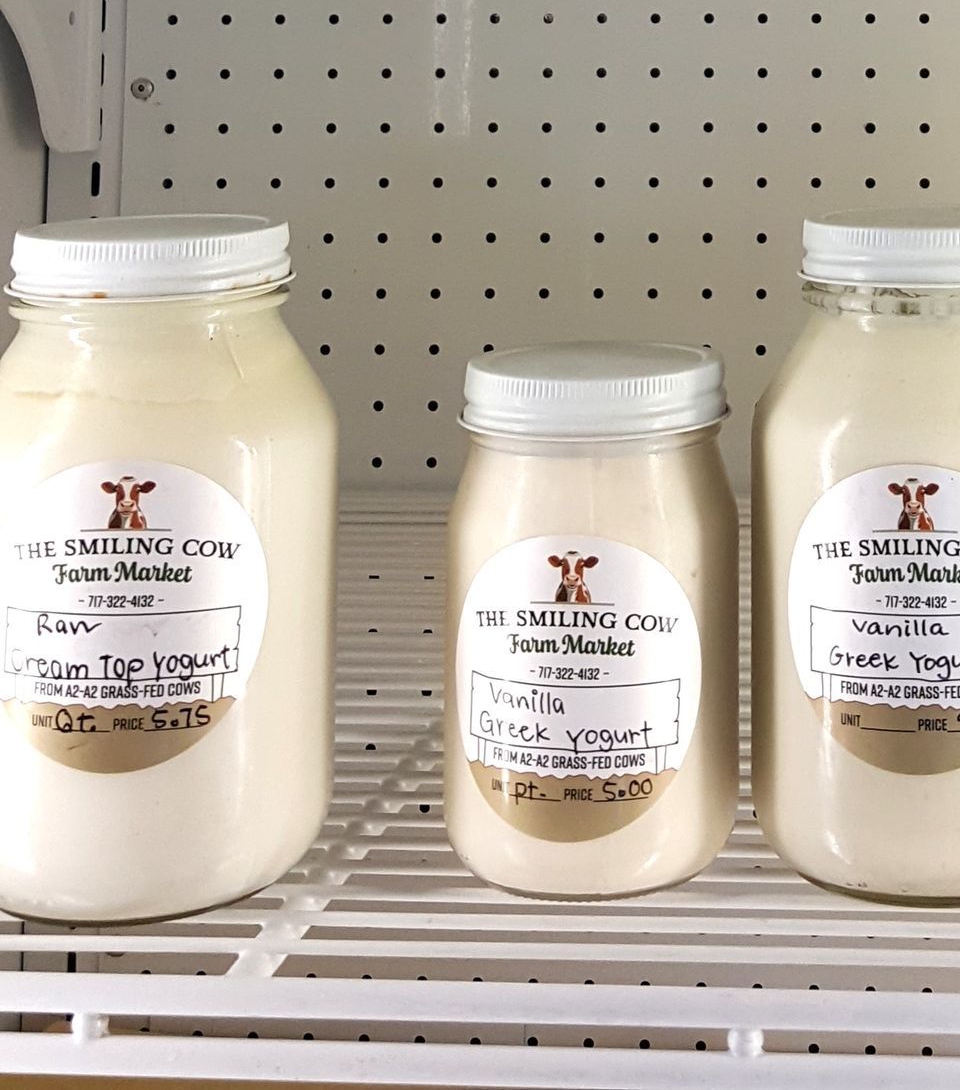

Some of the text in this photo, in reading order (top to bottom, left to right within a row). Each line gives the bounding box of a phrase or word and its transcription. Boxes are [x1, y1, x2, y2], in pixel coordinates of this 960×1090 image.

[14, 538, 242, 560] THE SMILING COW
[813, 540, 852, 560] THE
[860, 539, 960, 557] SMILING
[52, 561, 193, 585] Farm Market
[849, 563, 905, 584] Farm
[88, 595, 154, 608] 717-322-4132
[885, 596, 947, 608] 717-322-4132
[37, 614, 102, 636] Raw
[476, 610, 679, 633] THE SMILING COW
[508, 633, 636, 656] Farm Market
[830, 646, 899, 670] Greek
[538, 666, 599, 680] 717-322-4132
[101, 683, 164, 698] GRASS-FED
[490, 682, 564, 715] Vanilla
[870, 684, 900, 698] A2-A2
[113, 717, 144, 730] PRICE
[152, 705, 211, 728] 5.75
[480, 710, 550, 743] Greek
[841, 713, 860, 726] UNIT
[918, 719, 947, 731] PRICE
[552, 756, 611, 769] GRASS-FED
[564, 788, 592, 800] PRICE
[602, 780, 652, 801] 5.00
